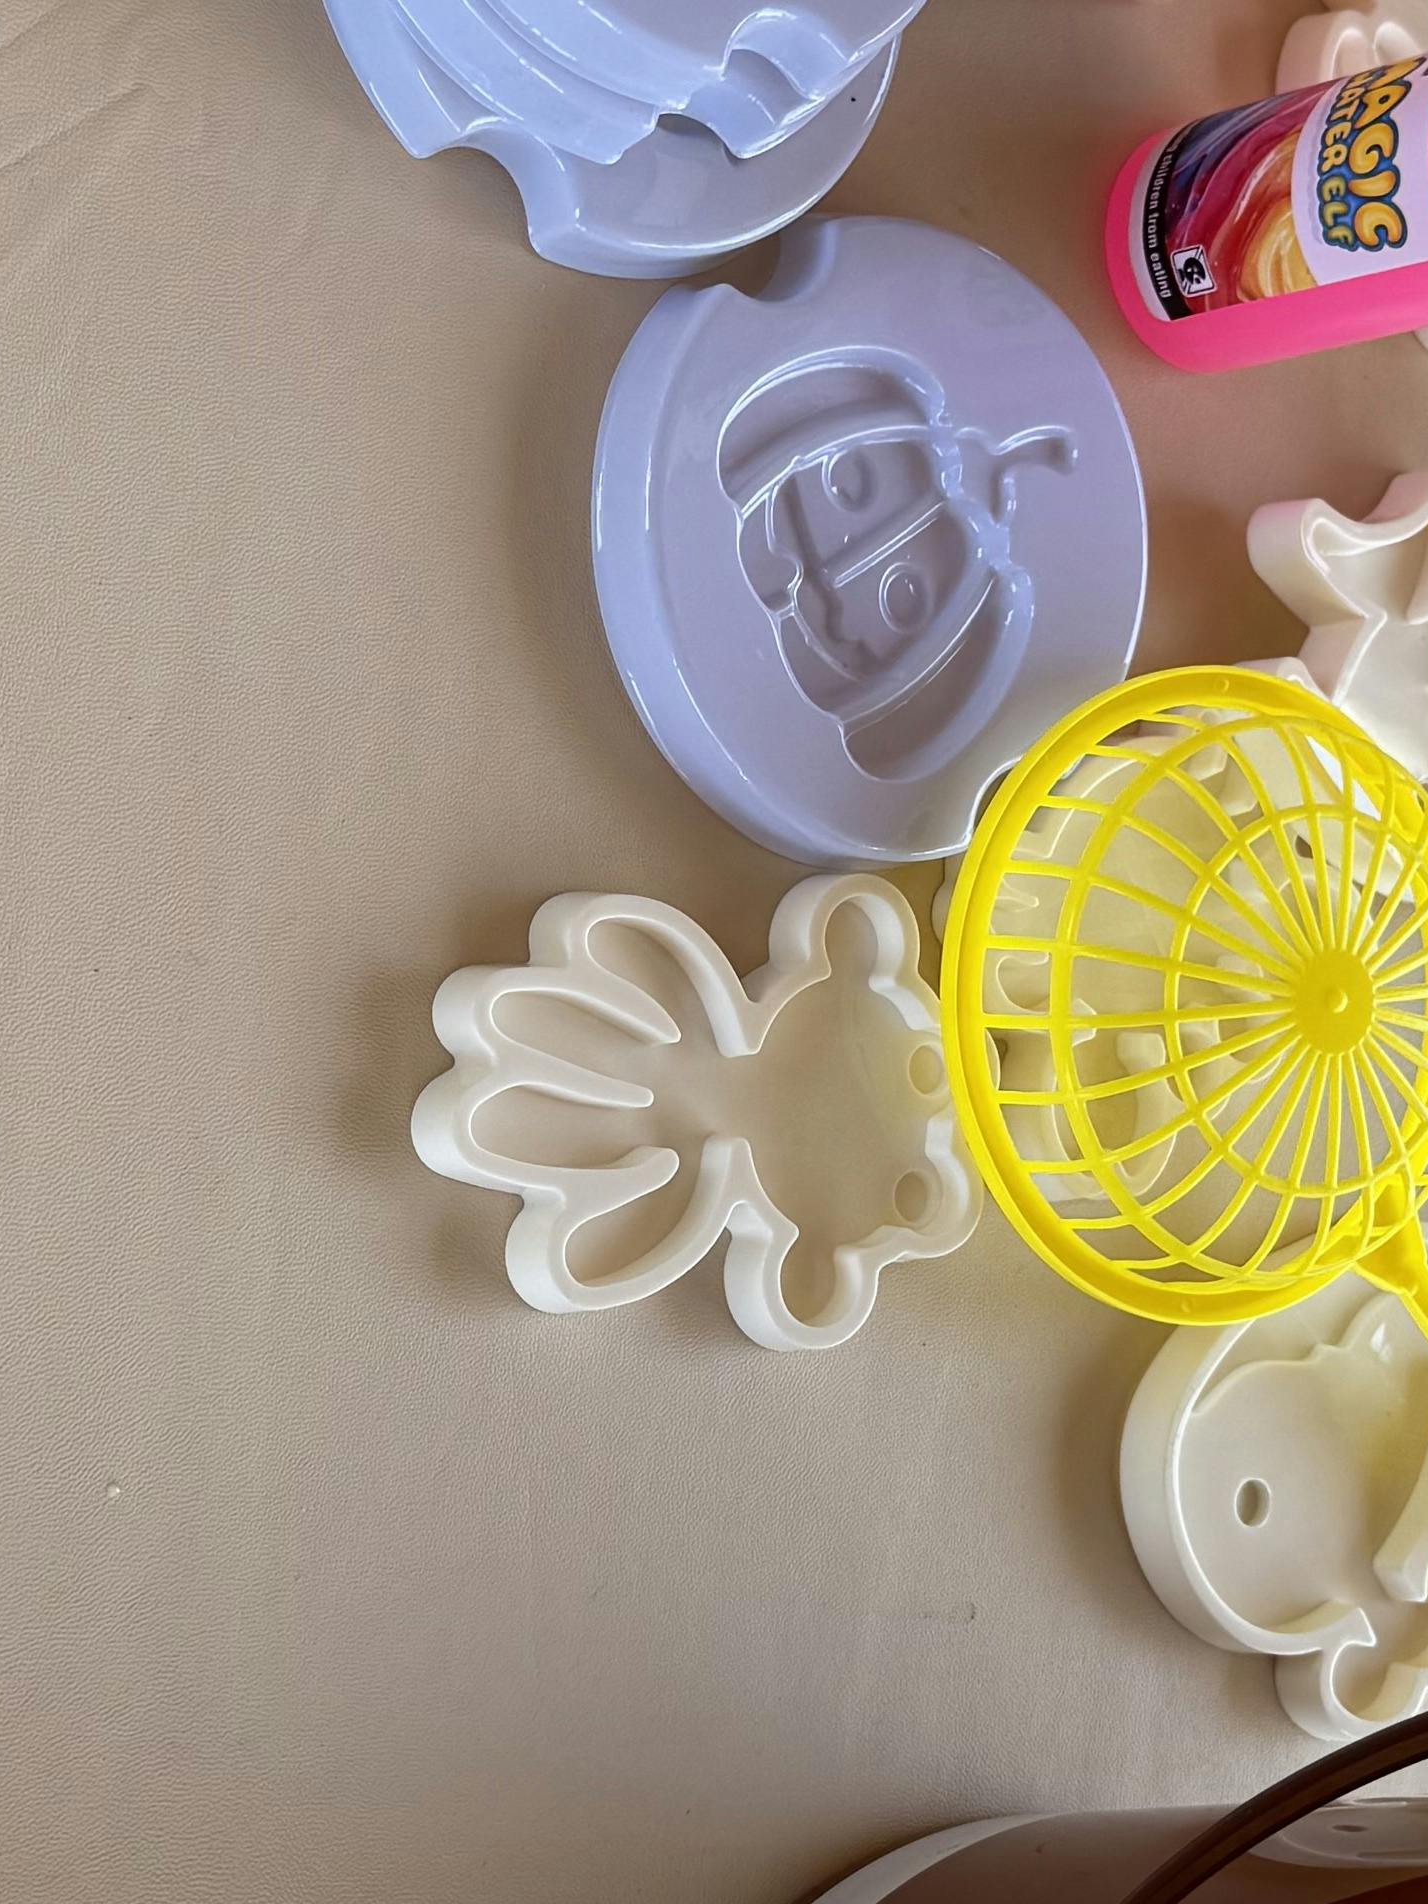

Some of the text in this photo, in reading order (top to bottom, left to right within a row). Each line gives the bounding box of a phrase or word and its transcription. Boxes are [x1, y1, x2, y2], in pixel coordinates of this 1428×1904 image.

[1318, 72, 1366, 175] WATER
[1348, 56, 1428, 252] MAGIC
[1148, 153, 1174, 209] children
[1319, 175, 1359, 252] ELF
[1146, 212, 1160, 249] from
[1148, 251, 1173, 299] eating
